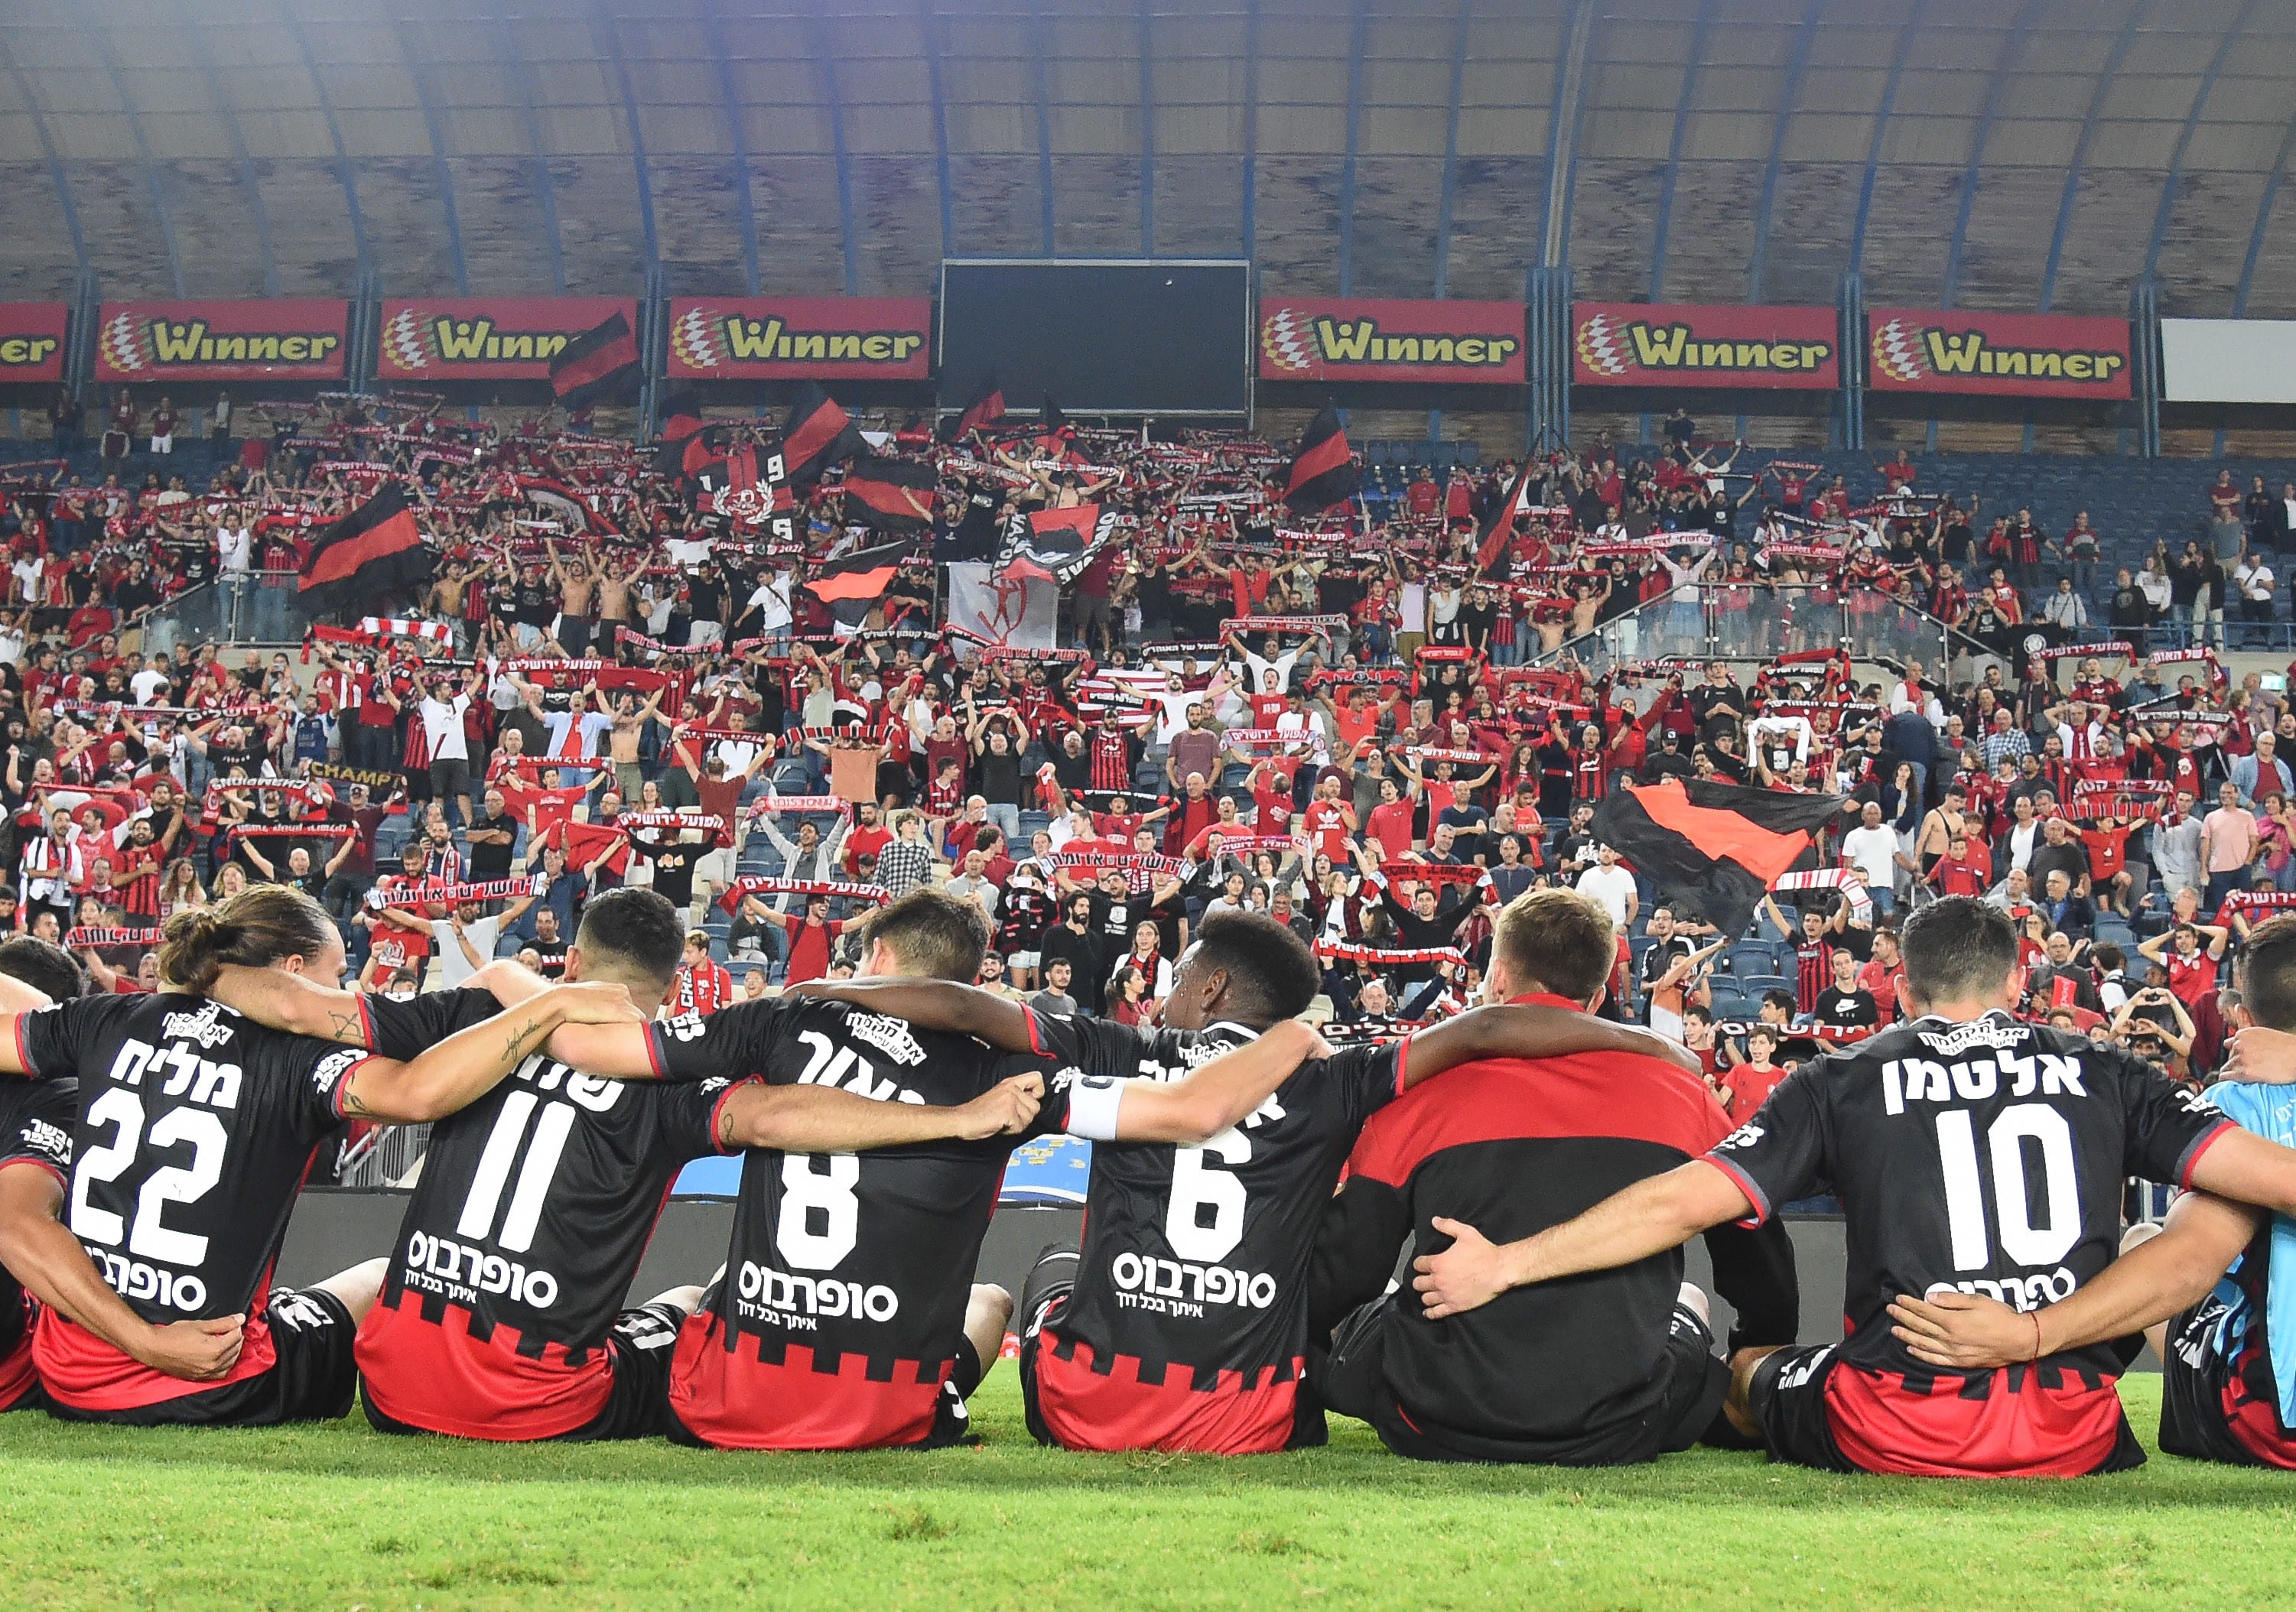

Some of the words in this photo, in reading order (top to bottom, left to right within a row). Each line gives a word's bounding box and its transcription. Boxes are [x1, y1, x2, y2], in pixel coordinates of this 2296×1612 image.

[154, 322, 337, 362] Winner
[437, 320, 568, 360] Winn
[727, 320, 922, 360] Winner
[1317, 320, 1517, 363] Winner
[1631, 324, 1829, 369] Winner
[1928, 331, 2122, 379] Winner
[768, 453, 784, 483] 9
[508, 660, 558, 671] ירושלים
[564, 658, 602, 671] הפועל
[186, 705, 270, 722] ירושלים
[680, 814, 724, 829] הפועל
[1051, 853, 1104, 869] אדומה
[1115, 855, 1183, 874] ירושלים
[384, 887, 446, 905] אדומה
[458, 879, 533, 902] ירושלים
[742, 878, 822, 895] ירושלים
[826, 882, 885, 902] הפועל
[1319, 937, 1374, 956] ירושלים
[1323, 1024, 1422, 1037] שלים
[109, 1038, 243, 1109] מליח
[797, 1029, 926, 1106] אור
[1881, 1048, 2088, 1116] אלטמן
[70, 1086, 229, 1268] 22
[456, 1090, 577, 1254] 11
[1164, 1126, 1253, 1264] 6
[1935, 1103, 2082, 1272] 10
[776, 1151, 860, 1272] 8
[84, 1245, 207, 1311] סופרב
[407, 1230, 558, 1308] סופרבוס
[421, 1271, 444, 1294] בכל
[1112, 1251, 1277, 1309] סופרבוס
[445, 1279, 478, 1305] איתך
[738, 1260, 899, 1322] סופרבוס
[1115, 1291, 1138, 1309] דרך
[1140, 1292, 1166, 1313] בכל
[757, 1303, 781, 1325] בכל
[782, 1311, 818, 1331] איתך
[1168, 1300, 1204, 1319] איתך
